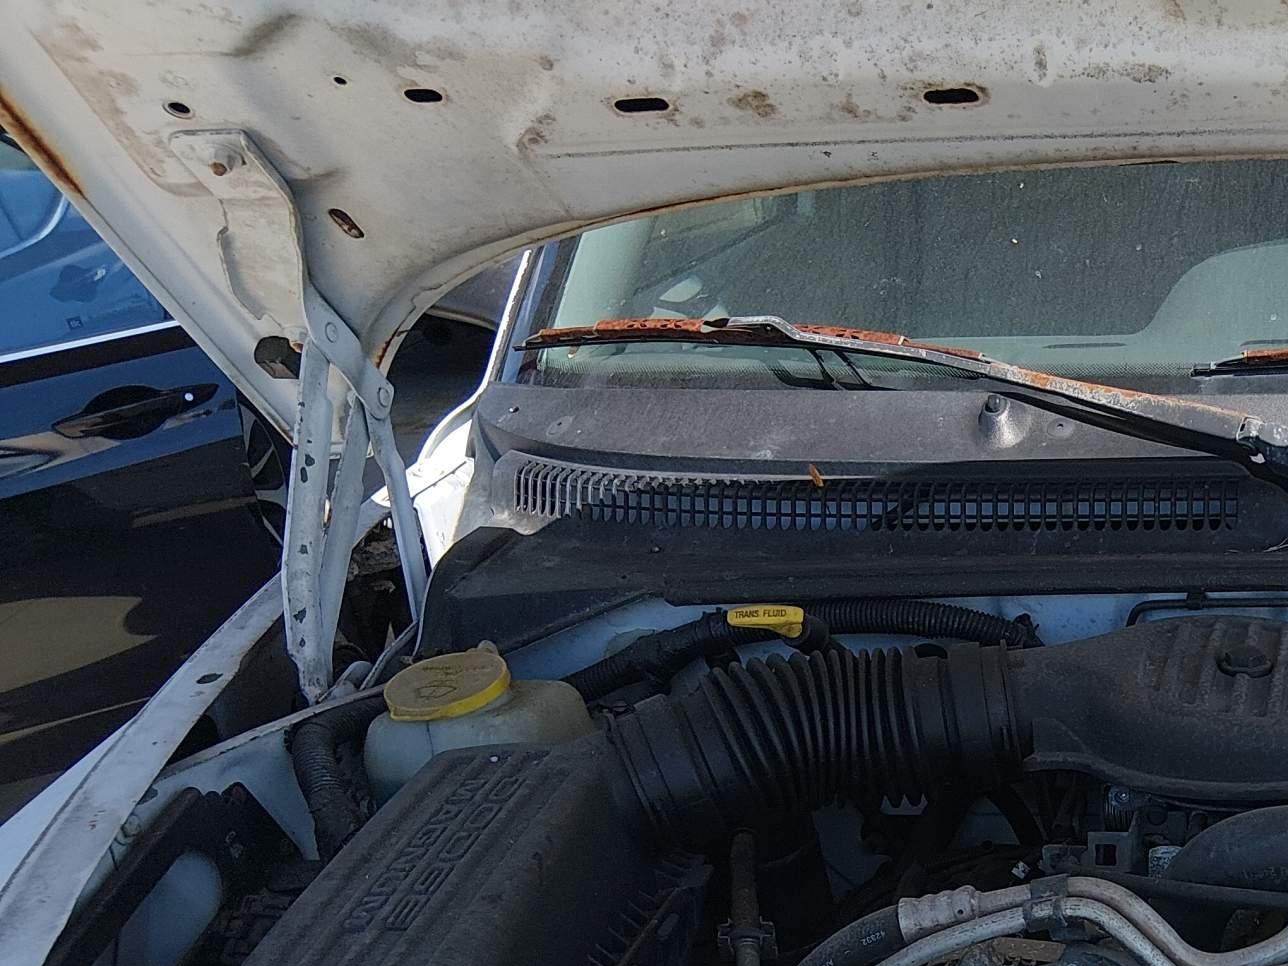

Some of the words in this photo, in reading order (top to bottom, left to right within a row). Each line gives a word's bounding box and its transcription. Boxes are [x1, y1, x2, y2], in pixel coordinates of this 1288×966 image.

[735, 610, 759, 618] TRANS
[763, 609, 787, 618] FLUID
[384, 776, 528, 932] DODGE
